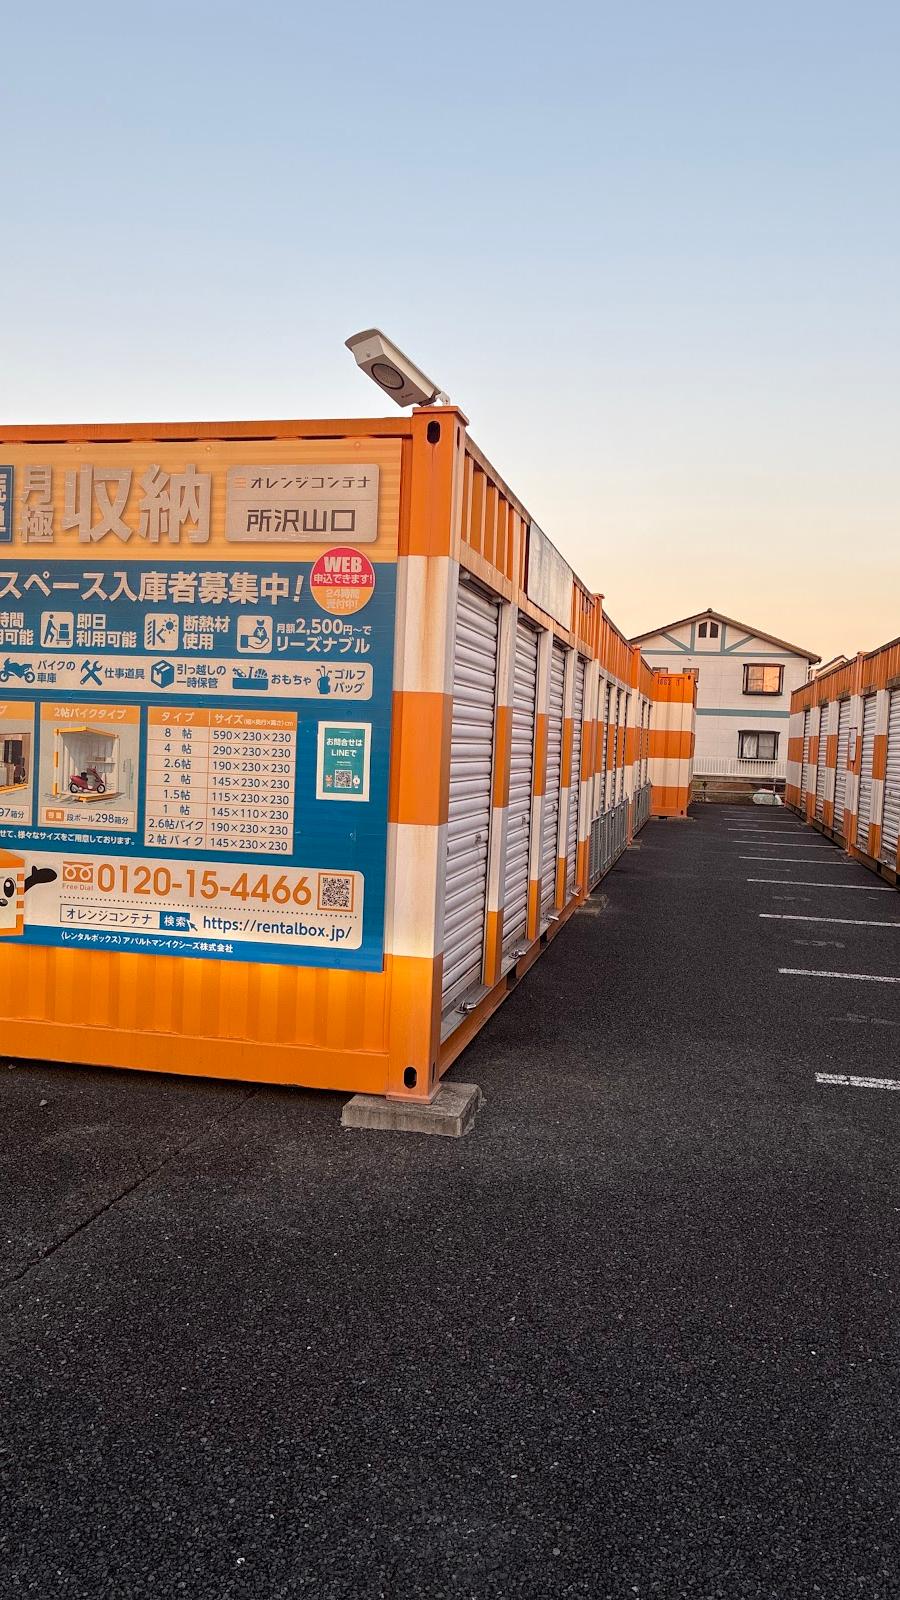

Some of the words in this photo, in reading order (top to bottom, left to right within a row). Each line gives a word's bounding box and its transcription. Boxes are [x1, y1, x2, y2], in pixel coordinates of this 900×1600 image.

[250, 475, 370, 489] オレンジコンテナ
[20, 464, 54, 543] 月極
[61, 464, 211, 543] 収納
[247, 509, 356, 533] 所沢山口
[324, 556, 362, 573] WEB
[313, 574, 373, 584] 申込できます!
[77, 613, 107, 630] 即日
[183, 615, 231, 633] 断熱材
[76, 631, 137, 648] 利用可能
[183, 633, 214, 650] 使用
[277, 636, 370, 654] リーズナブル
[37, 660, 76, 671] バイクの
[177, 664, 227, 676] 引っ越しの
[37, 673, 57, 683] 車庫
[104, 668, 145, 680] 仕事道具
[271, 674, 312, 686] おもちゃ
[334, 669, 366, 680] ゴルフ
[177, 677, 218, 689] 一時保管
[333, 683, 365, 694] バッグ
[54, 707, 126, 719] 2帖バイクタイプ
[161, 711, 195, 722] タイプ
[165, 728, 172, 738] 8
[182, 729, 192, 739] 帖
[164, 743, 171, 753] 4
[181, 744, 192, 754] 帖
[326, 738, 363, 747] お問合せは
[331, 749, 357, 757] LINEで
[164, 758, 191, 770] 2.6帖
[163, 774, 170, 783] 2
[181, 774, 191, 785] 帖
[163, 789, 191, 800] 1.5帖
[163, 804, 168, 814] 1
[180, 805, 190, 816] 帖
[66, 812, 129, 824] 段ボール298箱分
[148, 818, 204, 830] 2.6帖バイク
[148, 834, 203, 846] 2帖バイク
[97, 863, 312, 906] 0120-15-4466
[66, 908, 153, 925] オレンジコンテナ
[164, 915, 187, 928] 検索
[203, 916, 352, 941] https://rentalbox.jp/
